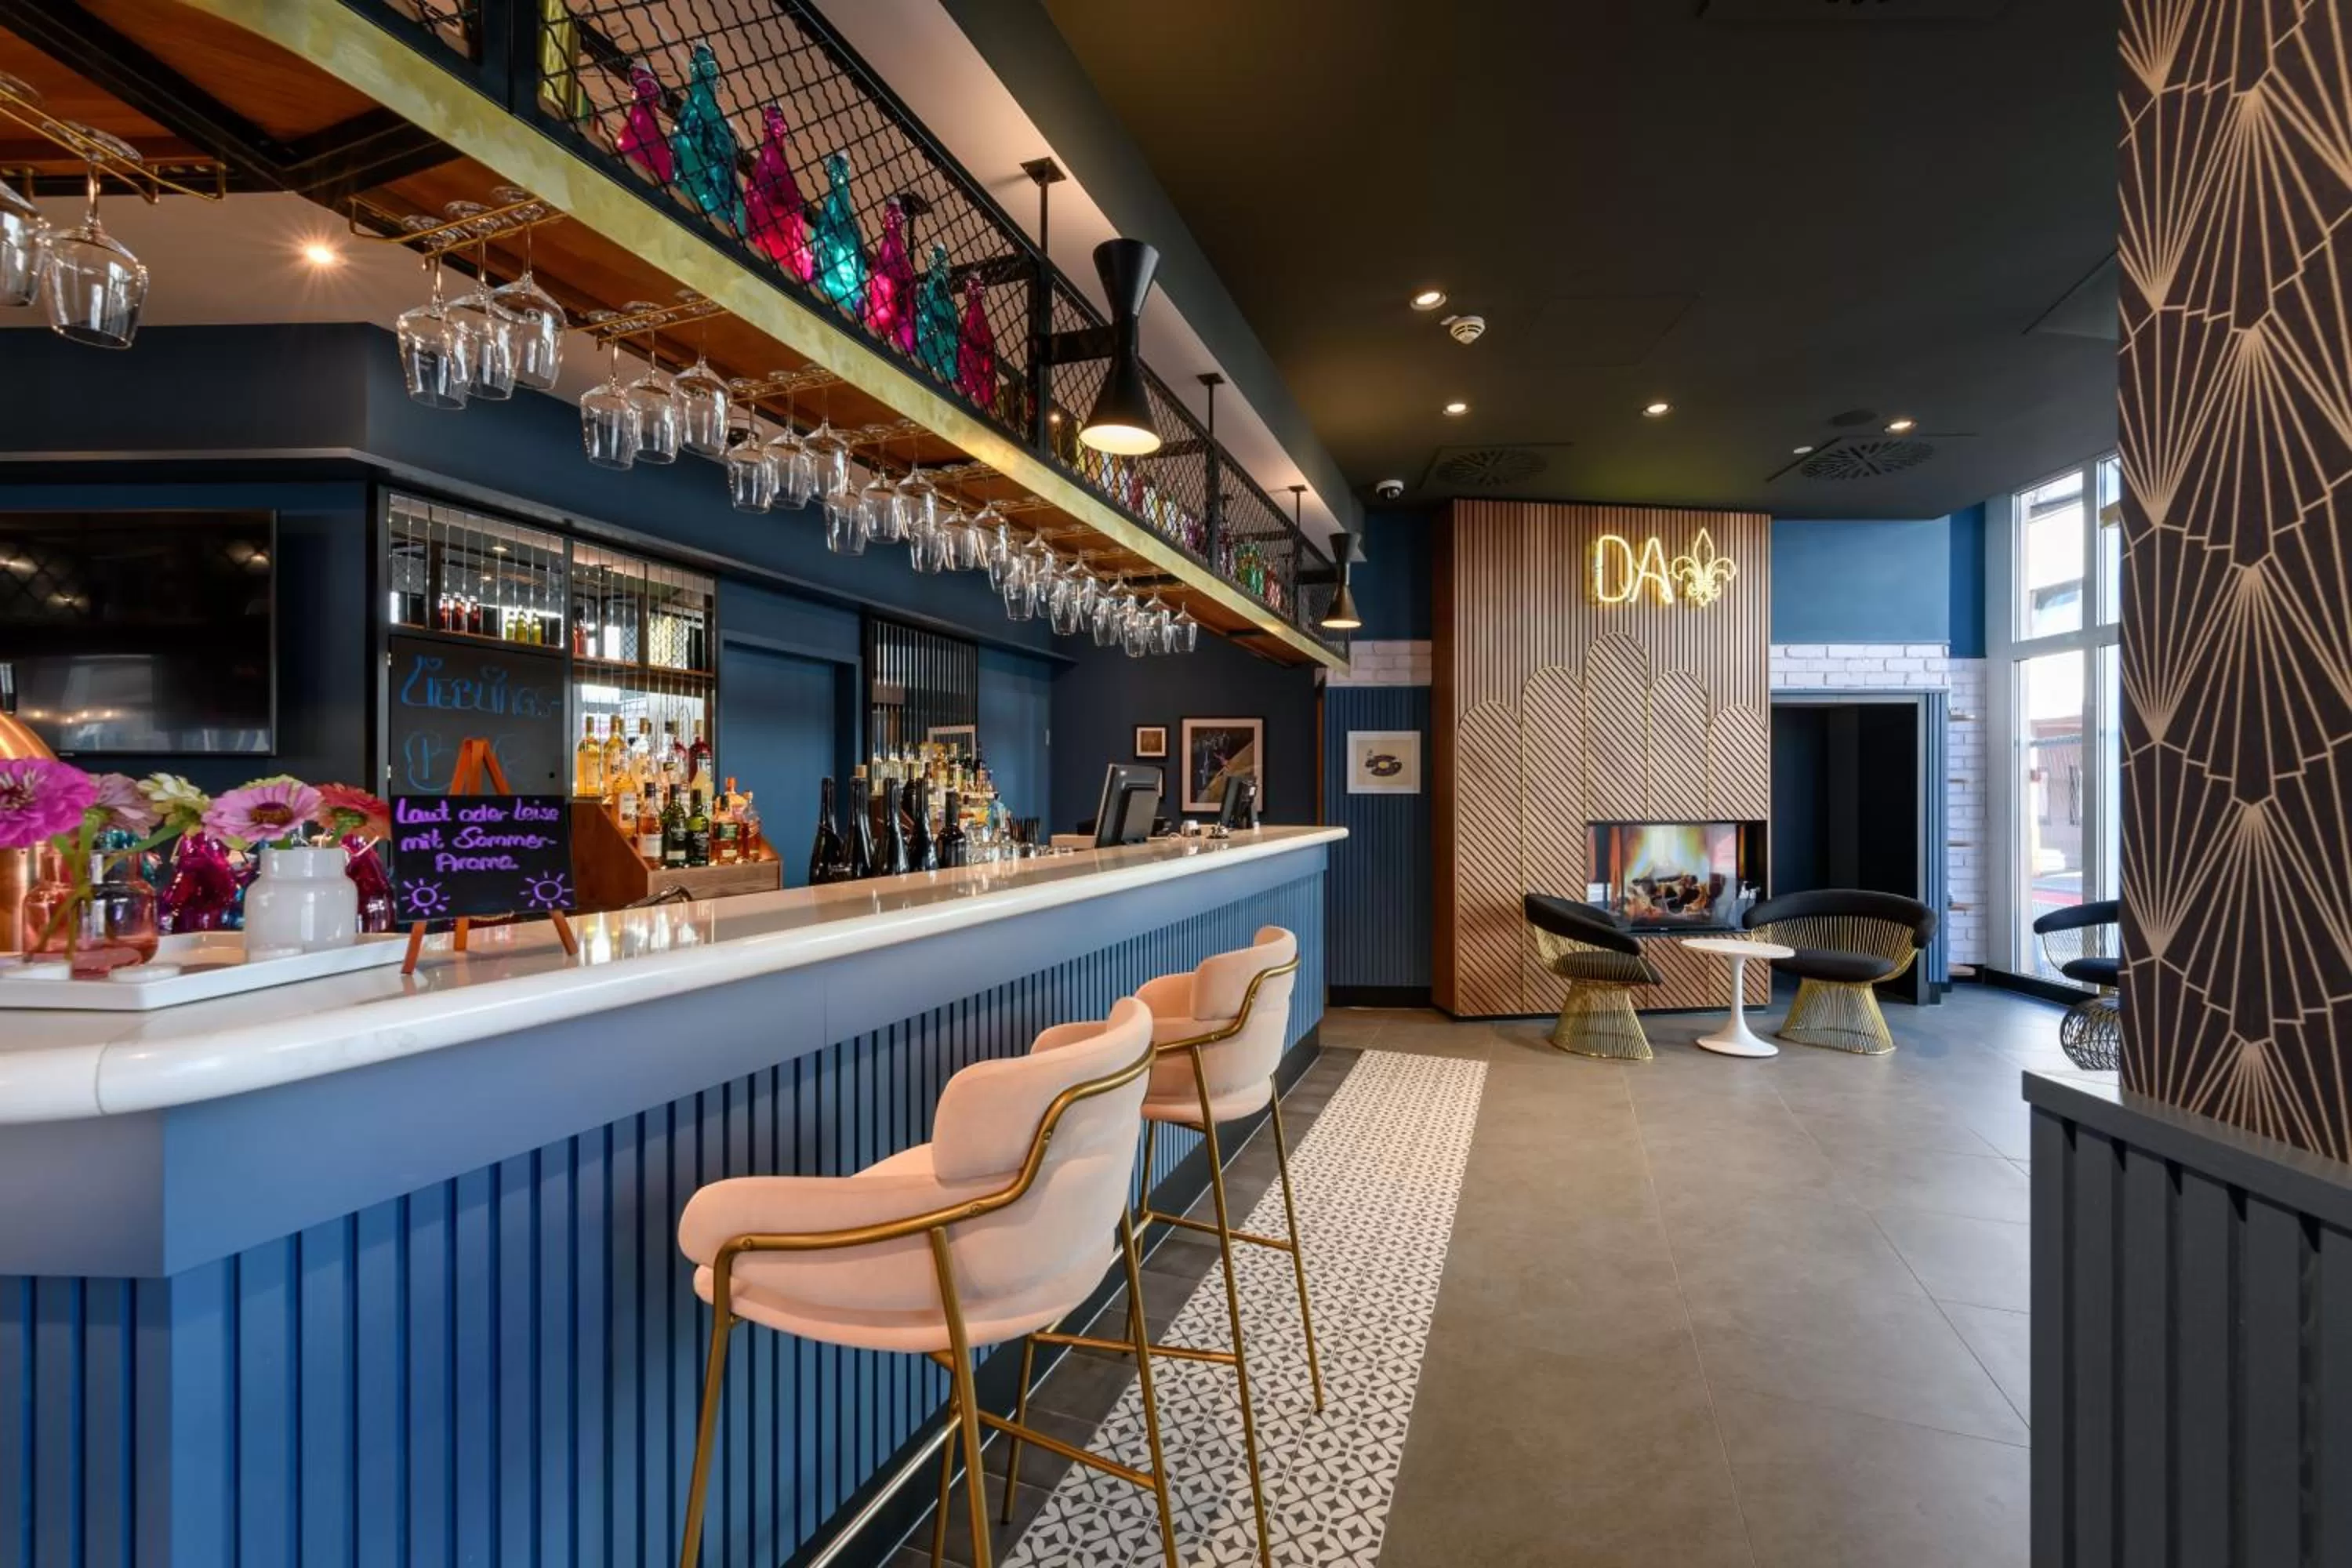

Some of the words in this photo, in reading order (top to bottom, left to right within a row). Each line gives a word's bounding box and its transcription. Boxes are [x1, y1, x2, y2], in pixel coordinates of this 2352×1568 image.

[395, 797, 452, 823] Laut
[458, 804, 510, 822] oder
[400, 827, 445, 852] mit
[434, 852, 520, 873] Aroma
